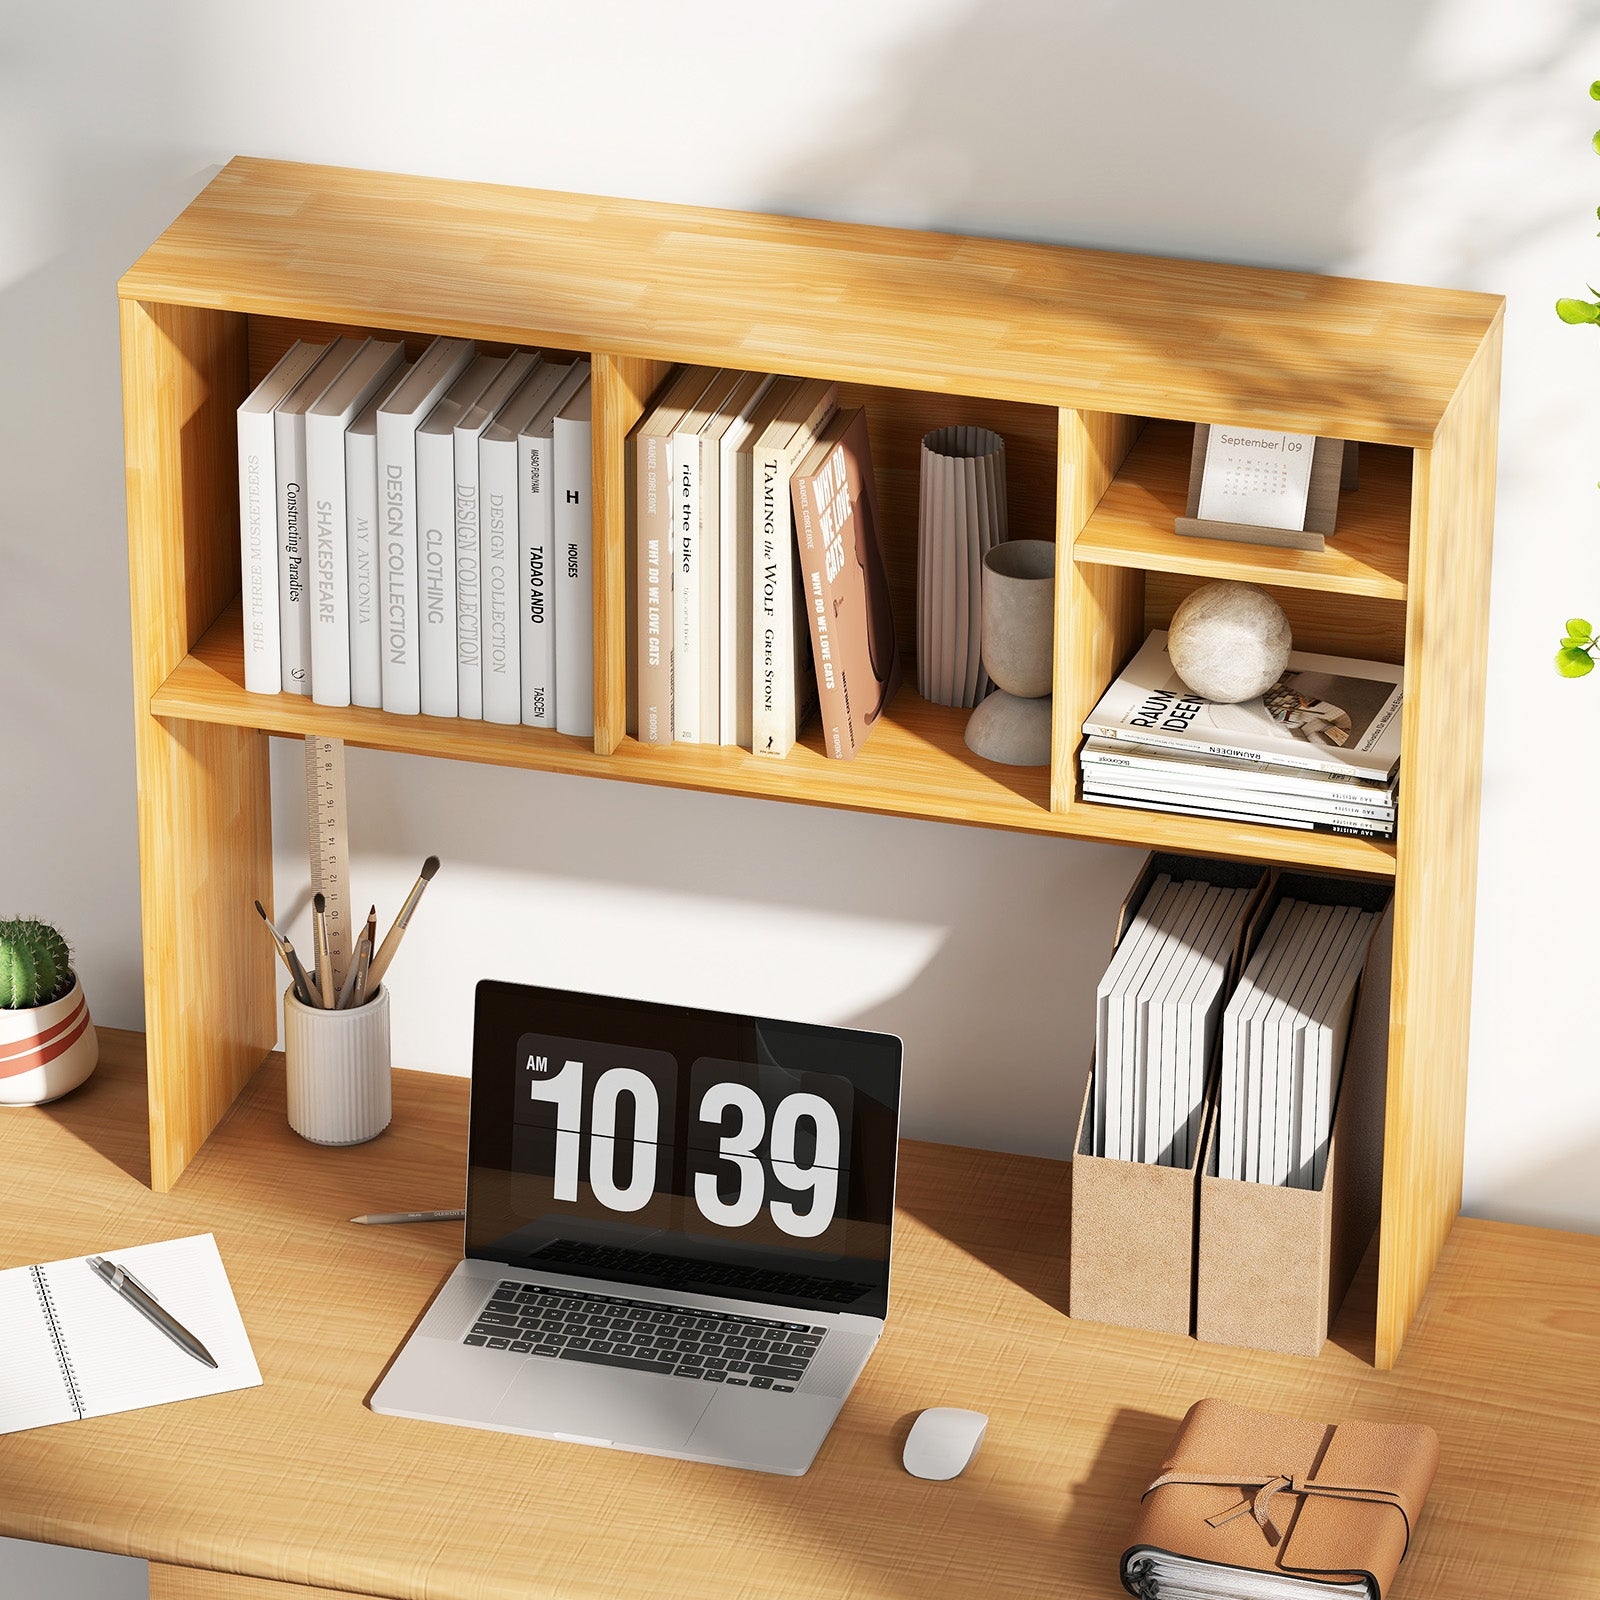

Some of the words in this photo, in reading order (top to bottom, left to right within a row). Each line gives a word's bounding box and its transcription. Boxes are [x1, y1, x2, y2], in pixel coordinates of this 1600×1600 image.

[648, 438, 656, 472] RAQUEL
[1221, 434, 1278, 450] September
[1288, 442, 1302, 452] 09
[648, 474, 657, 514] CORLEONE
[682, 464, 692, 498] ride
[764, 460, 777, 534] TAMING
[798, 480, 808, 510] RAQUEL
[812, 459, 834, 515] WHY
[832, 445, 846, 491] DO
[248, 455, 261, 560] MUSKETEERS
[286, 482, 302, 552] Constructing
[387, 464, 403, 536] DESIGN
[820, 507, 834, 550] WE
[832, 480, 852, 532] LOVE
[357, 518, 368, 546] MY
[457, 484, 476, 552] DESIGN
[490, 494, 504, 560] DESIGN
[682, 504, 692, 532] the
[802, 510, 814, 549] CORLEONE
[317, 500, 334, 624] SHAKESPEARE
[530, 546, 544, 586] TADAO
[568, 543, 578, 578] HOUSES
[648, 540, 658, 566] WHY
[682, 537, 692, 573] bike
[764, 540, 774, 560] the
[824, 534, 844, 584] CATS
[251, 564, 264, 616] THREE
[290, 556, 302, 602] Paradies
[358, 550, 370, 624] ANTONIA
[426, 529, 444, 624] CLOTHING
[648, 568, 659, 584] DO
[764, 564, 777, 616] WOLF
[811, 572, 822, 596] WHY
[388, 542, 406, 664] COLLECTION
[458, 558, 478, 668] COLLECTION
[530, 588, 544, 624] ANDO
[648, 586, 659, 606] WE
[814, 598, 824, 614] DO
[490, 564, 506, 674] COLLECTION
[648, 607, 659, 635] LOVE
[817, 615, 828, 632] WE
[254, 622, 264, 652] THE
[648, 637, 660, 666] CATS
[764, 629, 774, 666] GREG
[820, 634, 830, 660] LOVE
[764, 670, 774, 712] STONE
[823, 662, 835, 690] CATS
[534, 687, 544, 718] TASCEN
[1130, 689, 1177, 728] RAUM
[1160, 694, 1206, 732] IDEEN
[650, 714, 658, 742] BOOKS
[324, 744, 332, 752] 19
[834, 734, 842, 759] BOOKS
[1210, 746, 1261, 760] RAUMIDEEN
[326, 762, 332, 771] 18
[327, 800, 334, 808] 16
[328, 819, 335, 827] 15
[1332, 826, 1358, 834] MEISTER
[329, 837, 336, 846] 14
[330, 856, 336, 864] 13
[330, 874, 338, 882] 12
[332, 911, 338, 920] 10
[526, 1055, 548, 1072] AM
[531, 1060, 659, 1212] 10
[694, 1082, 840, 1238] 39
